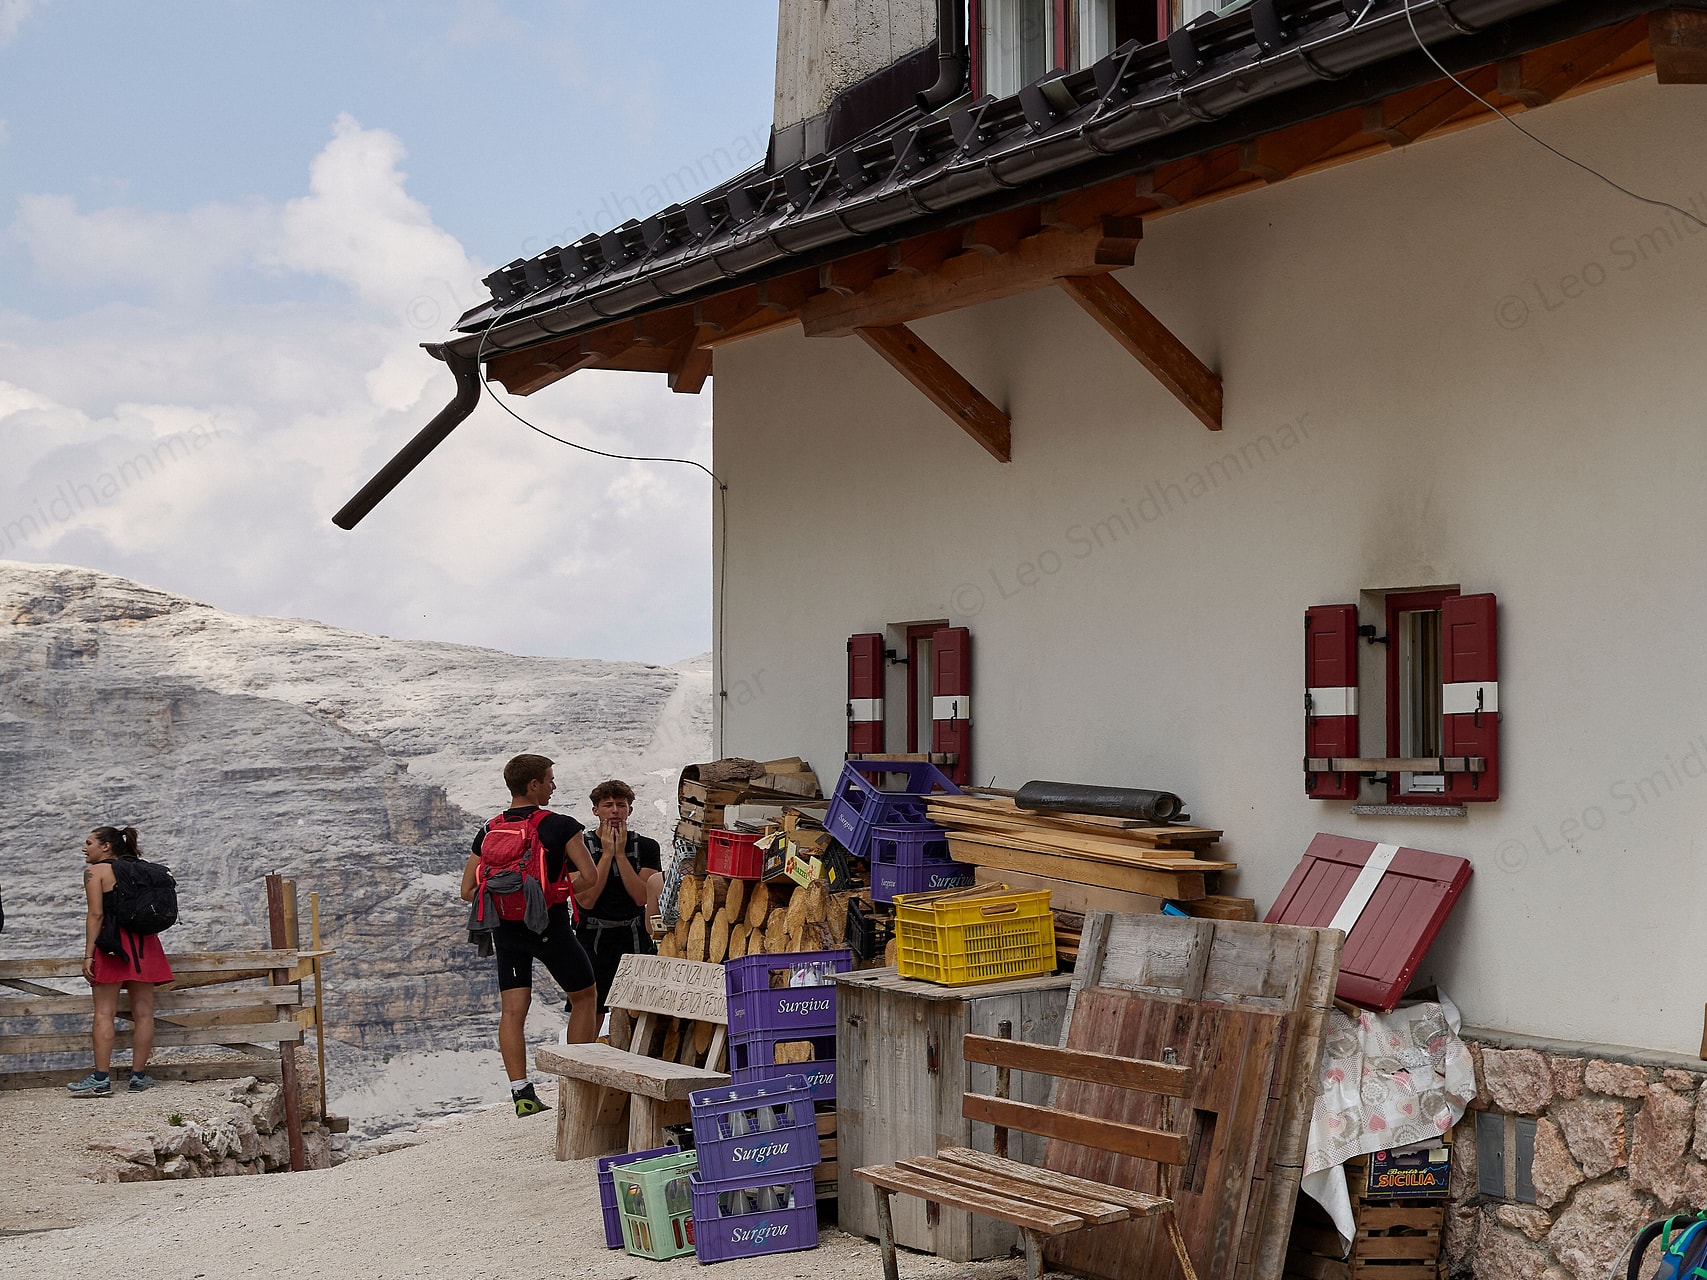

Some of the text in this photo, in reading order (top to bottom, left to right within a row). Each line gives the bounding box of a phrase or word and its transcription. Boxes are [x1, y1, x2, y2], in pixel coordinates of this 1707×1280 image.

[928, 874, 975, 888] Surgiva
[777, 998, 830, 1016] Surgiva
[732, 1141, 789, 1163] Surgiva
[1378, 1173, 1435, 1187] SICILIA
[731, 1223, 789, 1244] Surgiva
